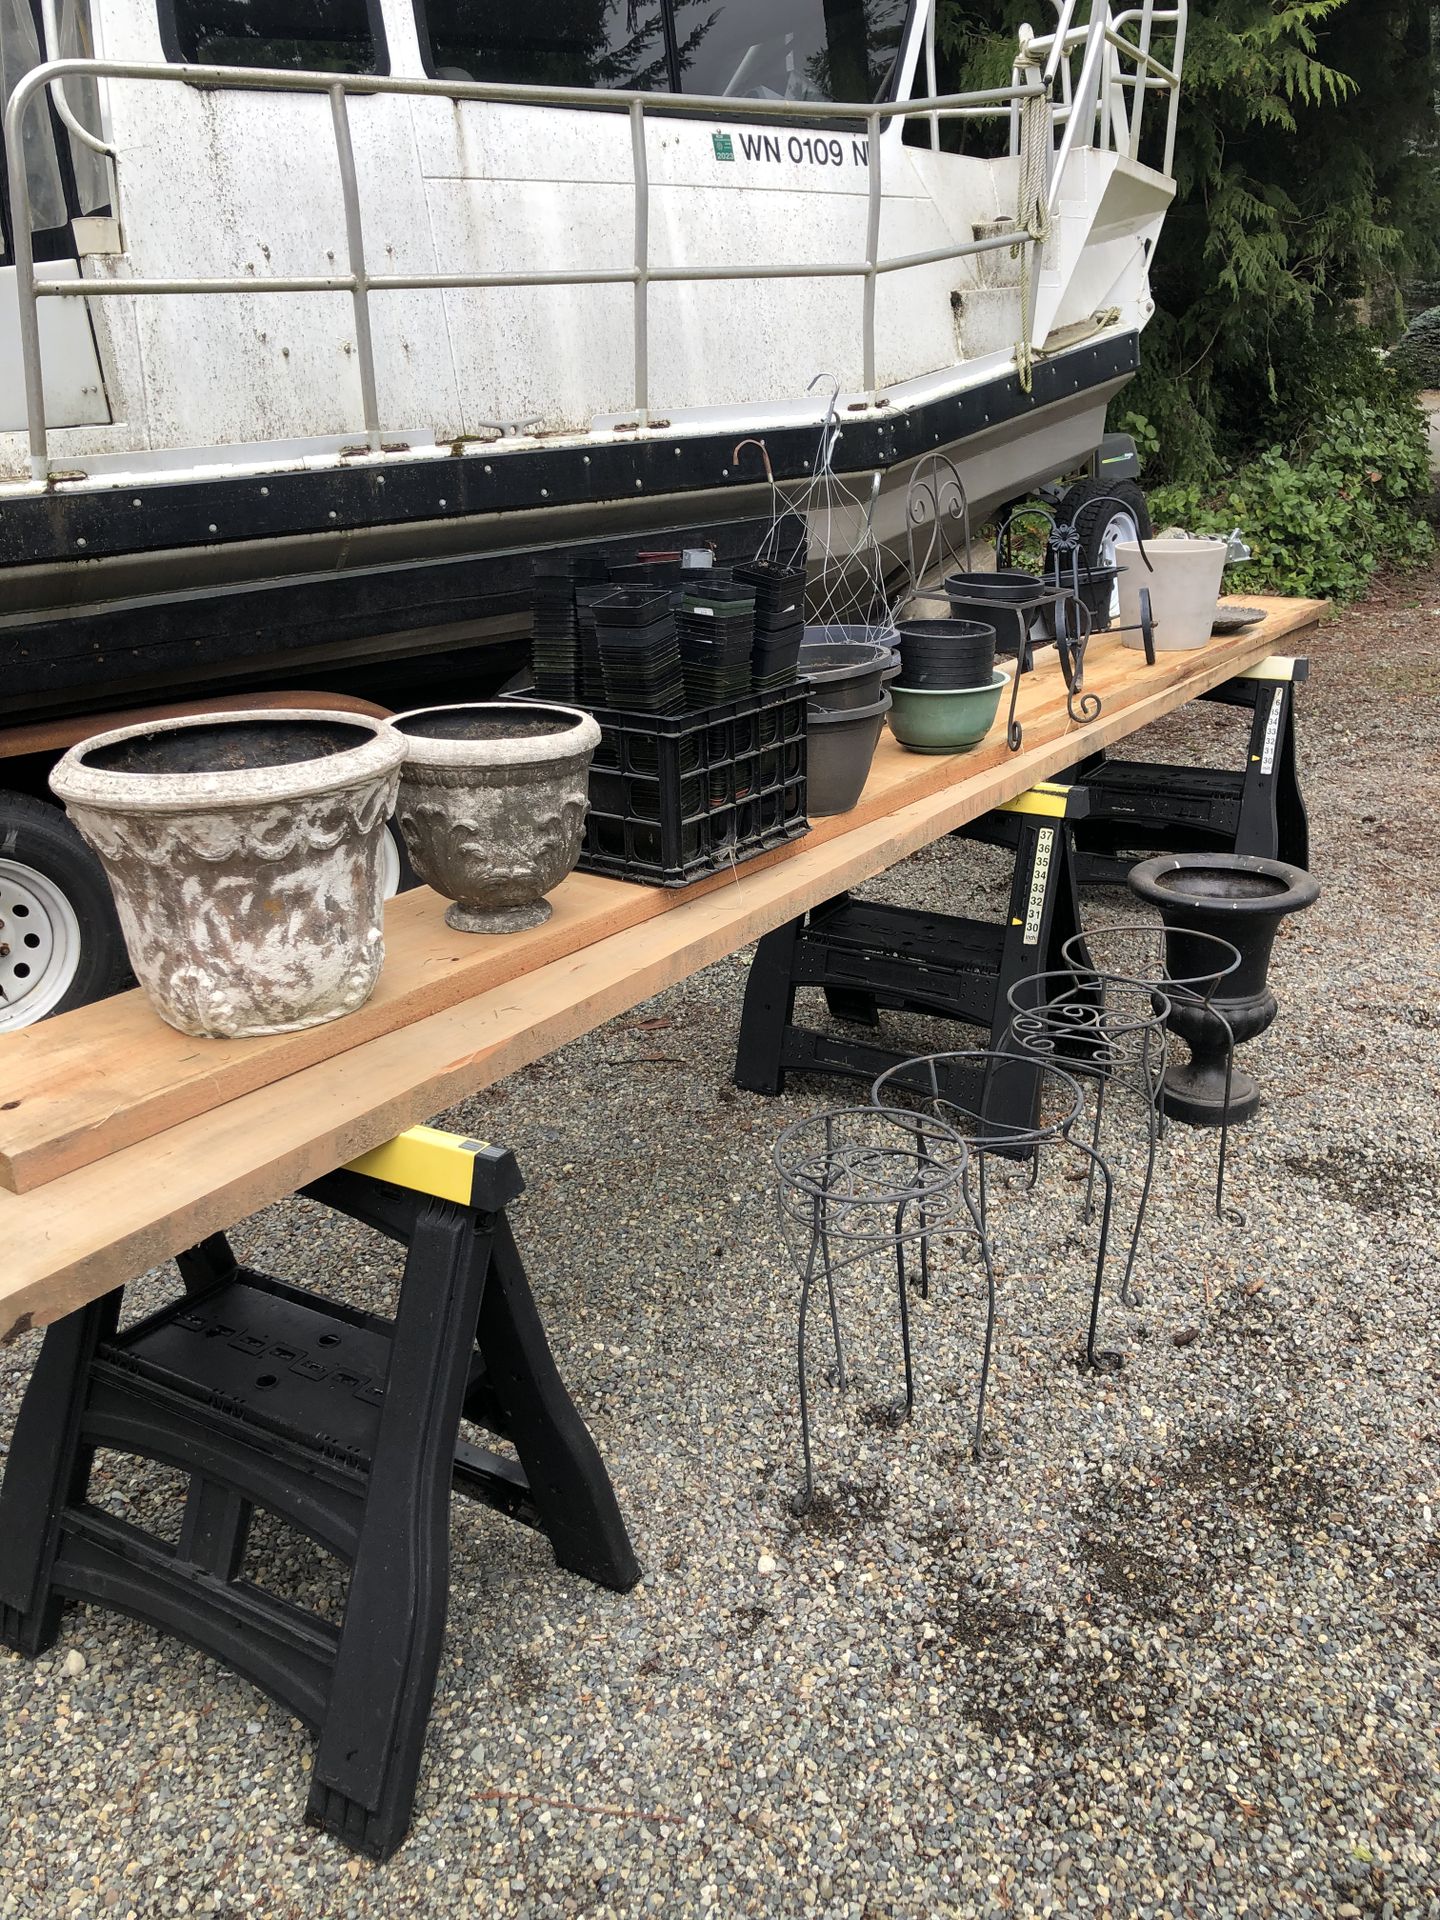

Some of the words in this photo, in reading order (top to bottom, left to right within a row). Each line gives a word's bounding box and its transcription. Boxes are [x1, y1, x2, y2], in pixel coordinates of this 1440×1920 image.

[738, 133, 782, 163] WN
[788, 136, 843, 167] 0109
[851, 140, 869, 166] N
[1040, 831, 1052, 840] 37
[1038, 844, 1050, 854] 36
[1036, 857, 1048, 867] 35
[1034, 870, 1046, 880] 34
[1032, 884, 1044, 893] 33
[1030, 897, 1042, 906] 32
[1028, 910, 1040, 919] 31
[1026, 923, 1038, 932] 30
